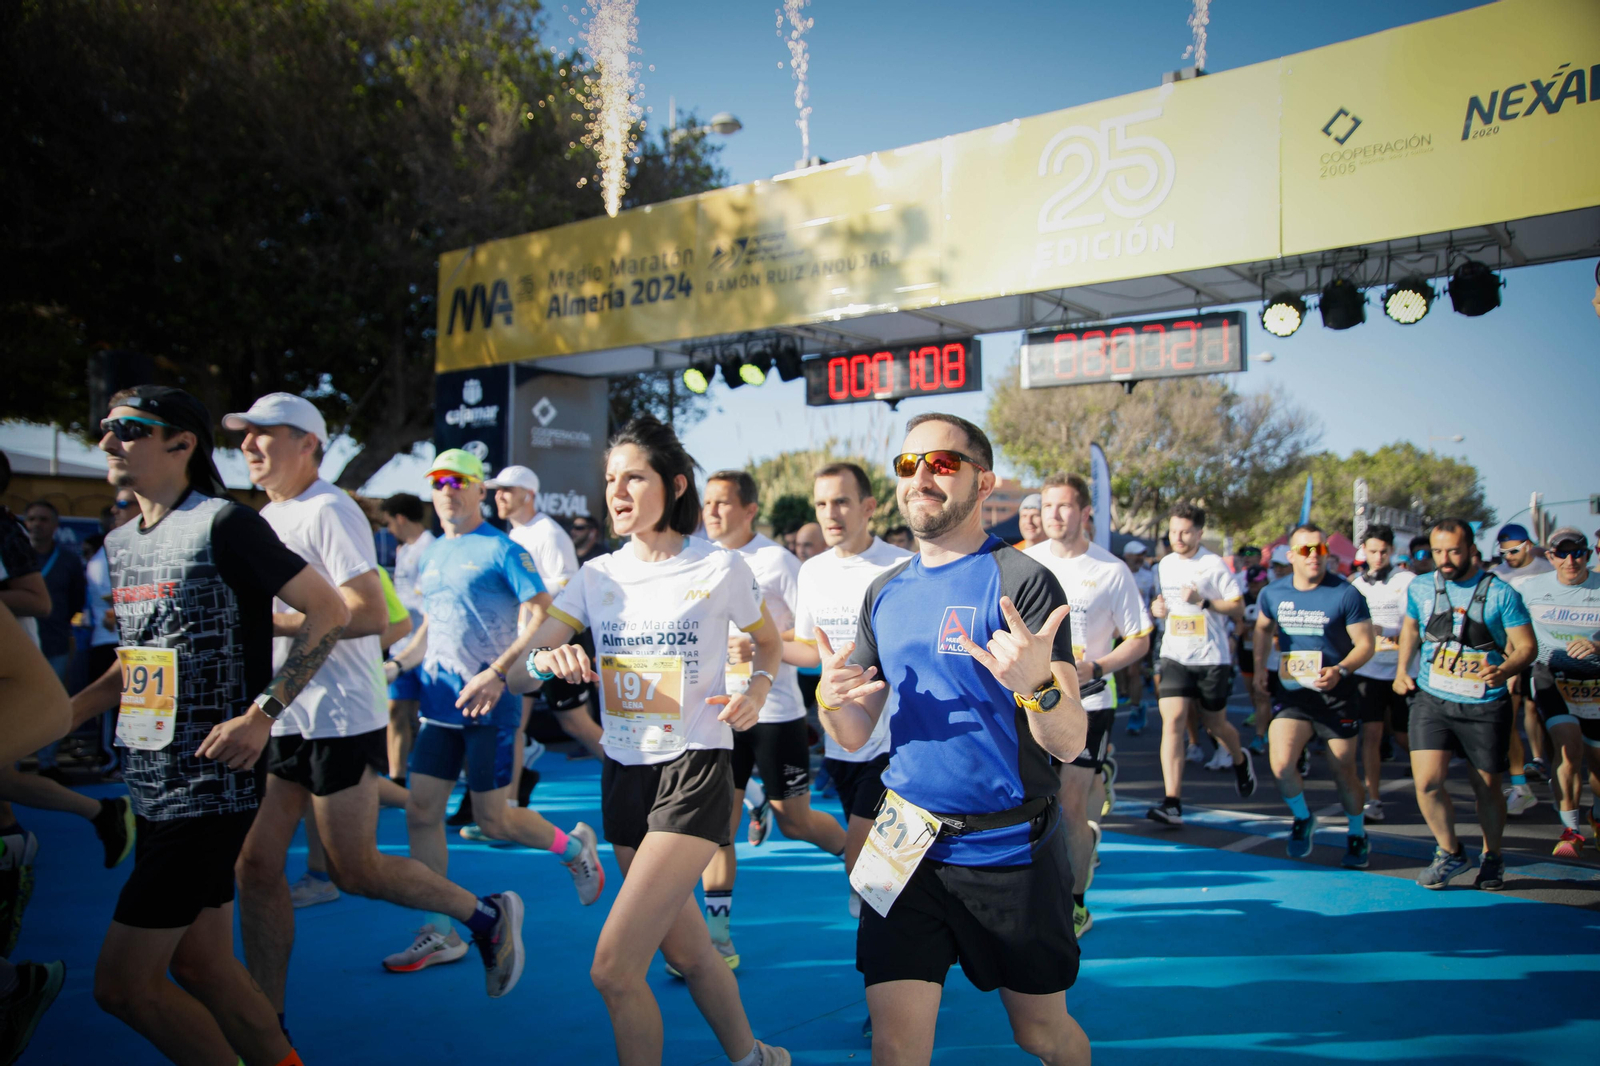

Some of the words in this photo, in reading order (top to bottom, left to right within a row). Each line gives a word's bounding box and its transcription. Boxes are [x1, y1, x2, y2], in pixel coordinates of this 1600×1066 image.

[1471, 125, 1500, 140] 2020
[1320, 133, 1432, 165] COOPERACIÓN
[1037, 106, 1177, 235] 25
[1320, 161, 1356, 178] 2005
[1035, 219, 1176, 269] EDICIÓN
[549, 263, 603, 288] Medio
[609, 247, 694, 277] Maratón
[767, 265, 804, 284] RUIZ
[546, 281, 626, 319] Almería
[630, 272, 693, 306] 2024
[445, 403, 500, 429] cajamar
[601, 620, 637, 631] Medio
[642, 619, 699, 630] Maratón
[1557, 609, 1600, 622] MOTRI
[602, 632, 653, 647] Almería
[657, 632, 698, 646] 2024
[613, 671, 662, 700] 197
[621, 701, 644, 710] ELENA
